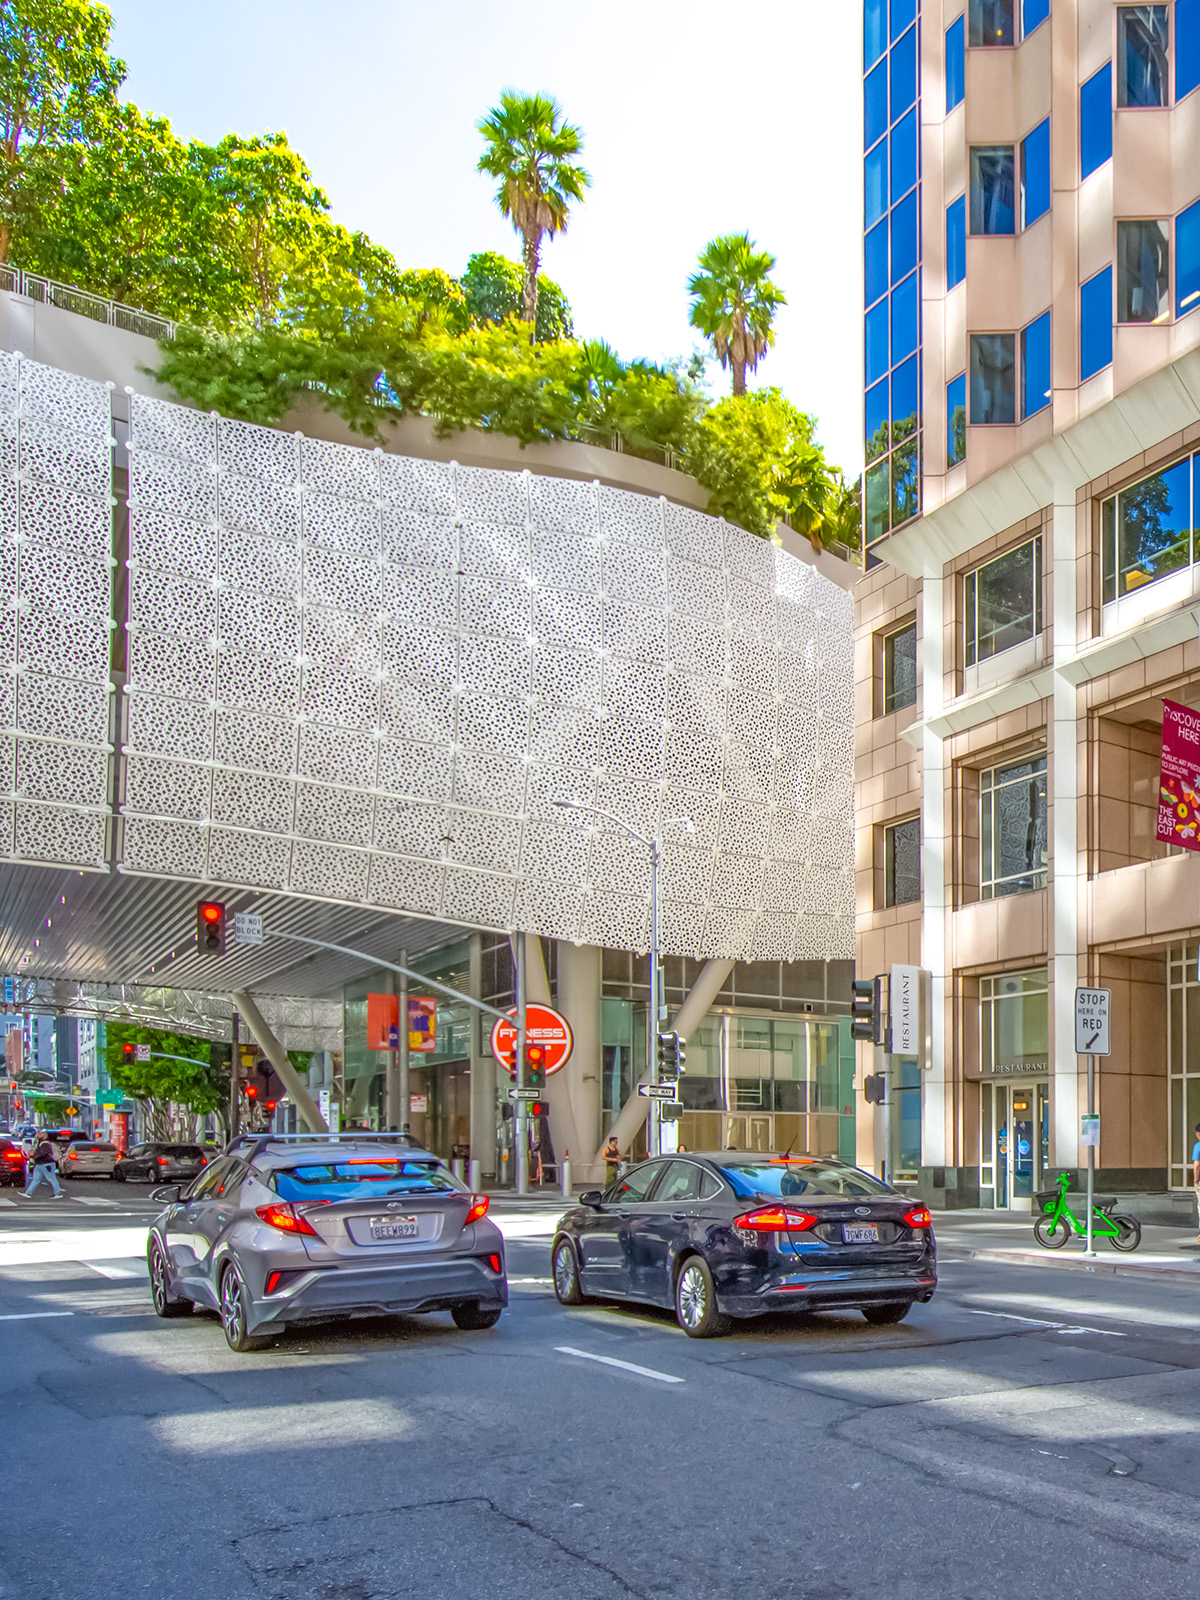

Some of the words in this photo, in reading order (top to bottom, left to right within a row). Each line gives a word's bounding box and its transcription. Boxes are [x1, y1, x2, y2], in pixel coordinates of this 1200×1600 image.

[1178, 725, 1200, 746] HERE
[1161, 752, 1178, 764] PUBLIC
[1161, 760, 1168, 769] TO
[1168, 762, 1189, 777] EXPLORE
[1159, 805, 1173, 818] THE
[1158, 814, 1177, 828] EAST
[1157, 824, 1173, 836] CUT
[236, 916, 245, 925] DO
[248, 918, 261, 926] NOT
[236, 927, 261, 935] BLOCK
[1079, 993, 1106, 1006] STOP
[902, 973, 910, 1050] RESTAURANT
[1077, 1007, 1095, 1016] HERE
[1098, 1008, 1107, 1016] ON
[1082, 1018, 1103, 1030] RED
[995, 1062, 1047, 1073] RESTAURANT
[845, 1230, 877, 1240] 7GWF686
